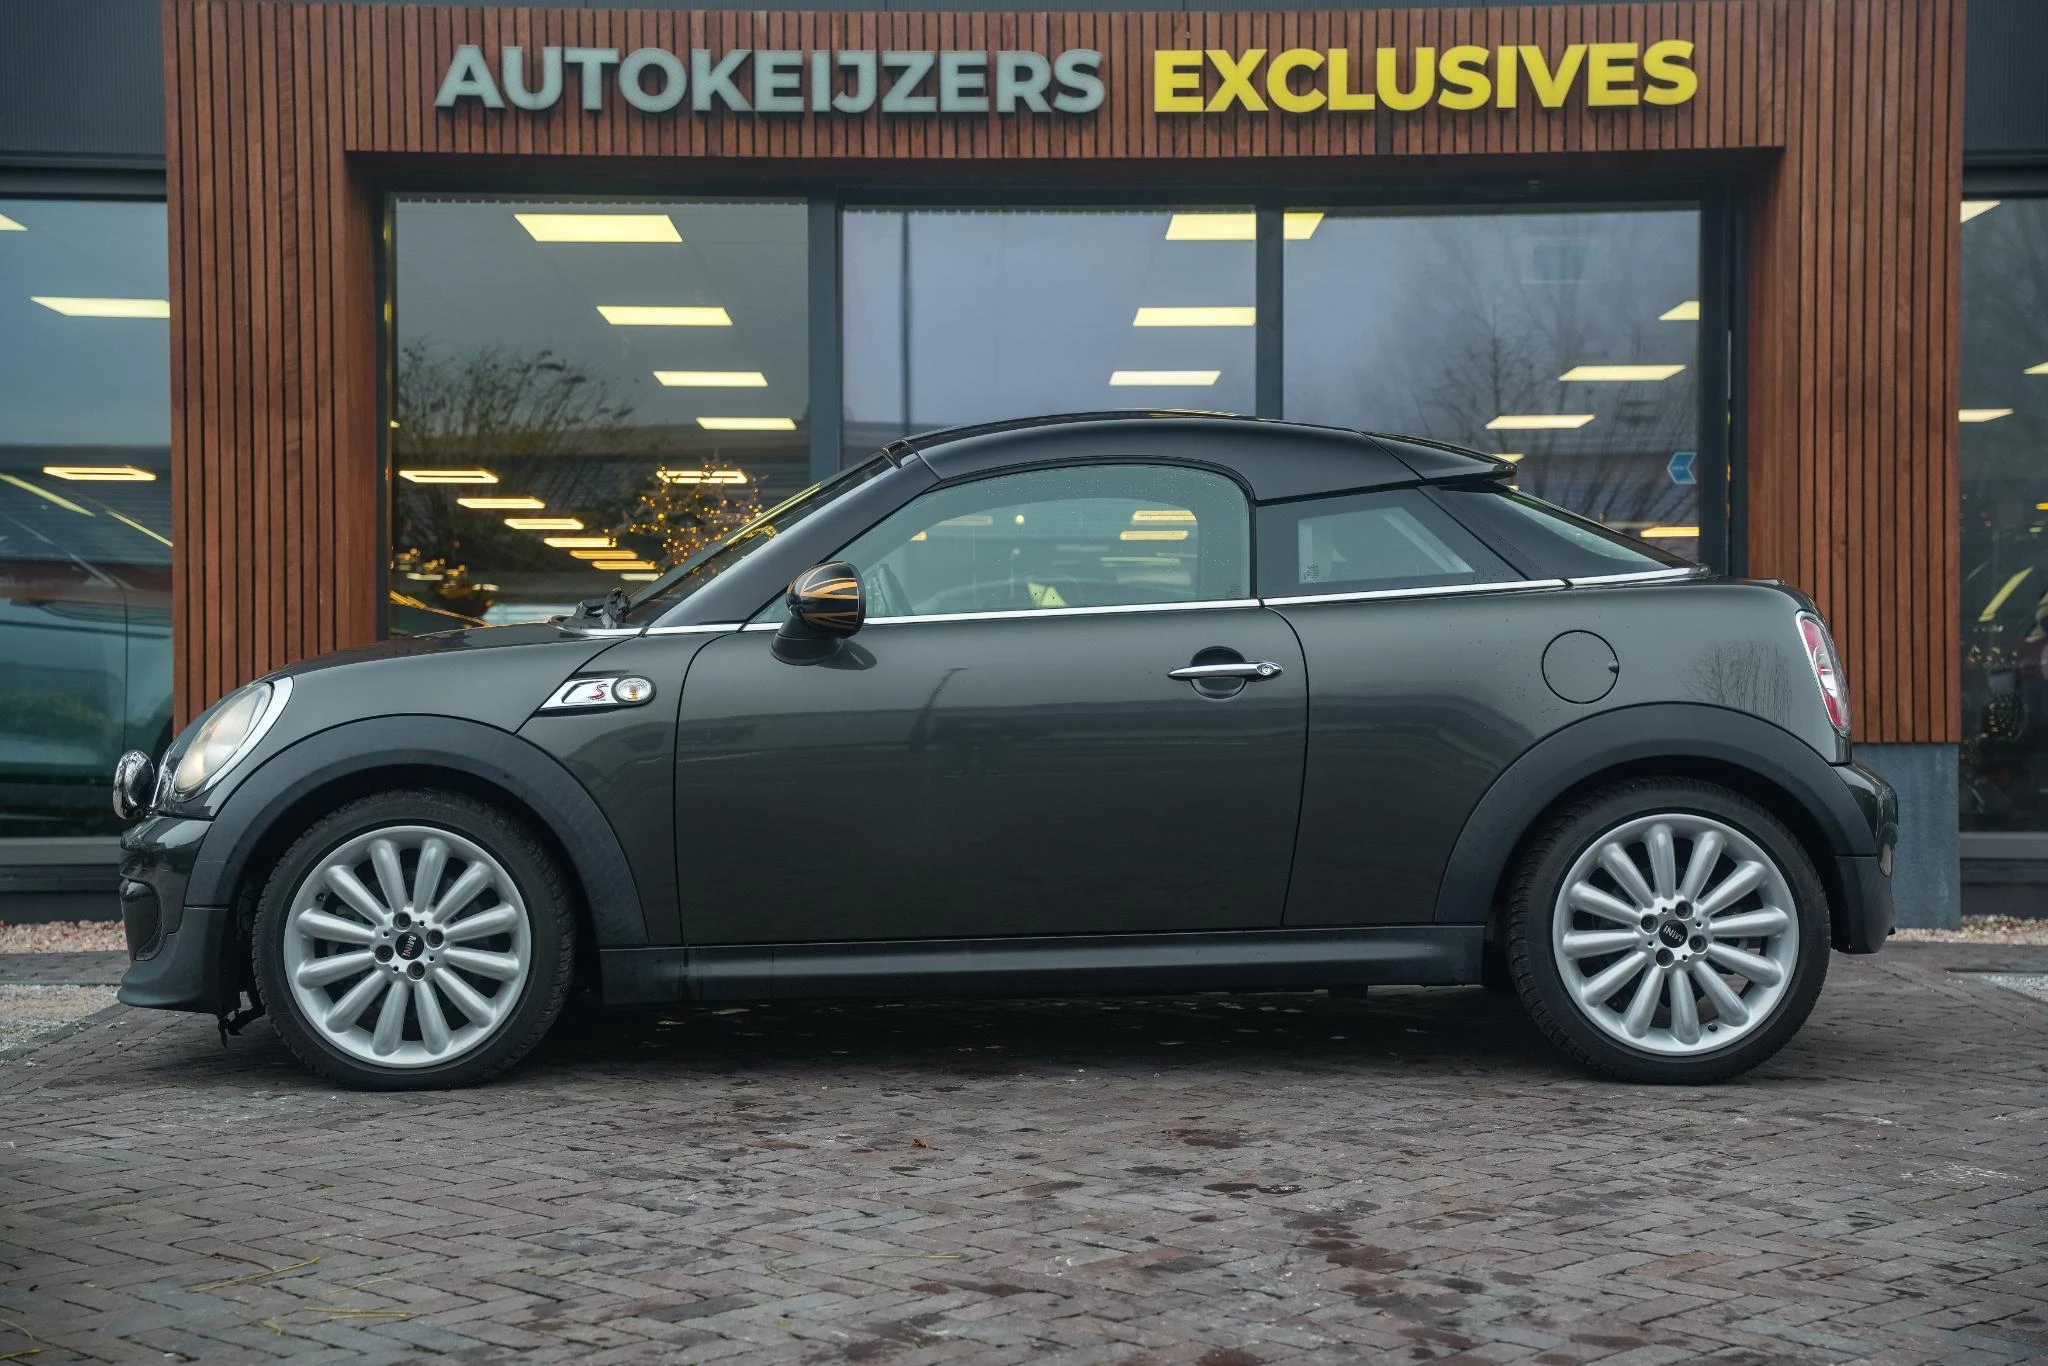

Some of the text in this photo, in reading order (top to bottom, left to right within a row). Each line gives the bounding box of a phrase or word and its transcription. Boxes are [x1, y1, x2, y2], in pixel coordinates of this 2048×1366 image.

[435, 39, 1699, 114] AUTOKEIJZERS EXCLUSIVES
[588, 683, 610, 701] S
[1662, 925, 1684, 942] MINI
[402, 935, 417, 957] MINI
